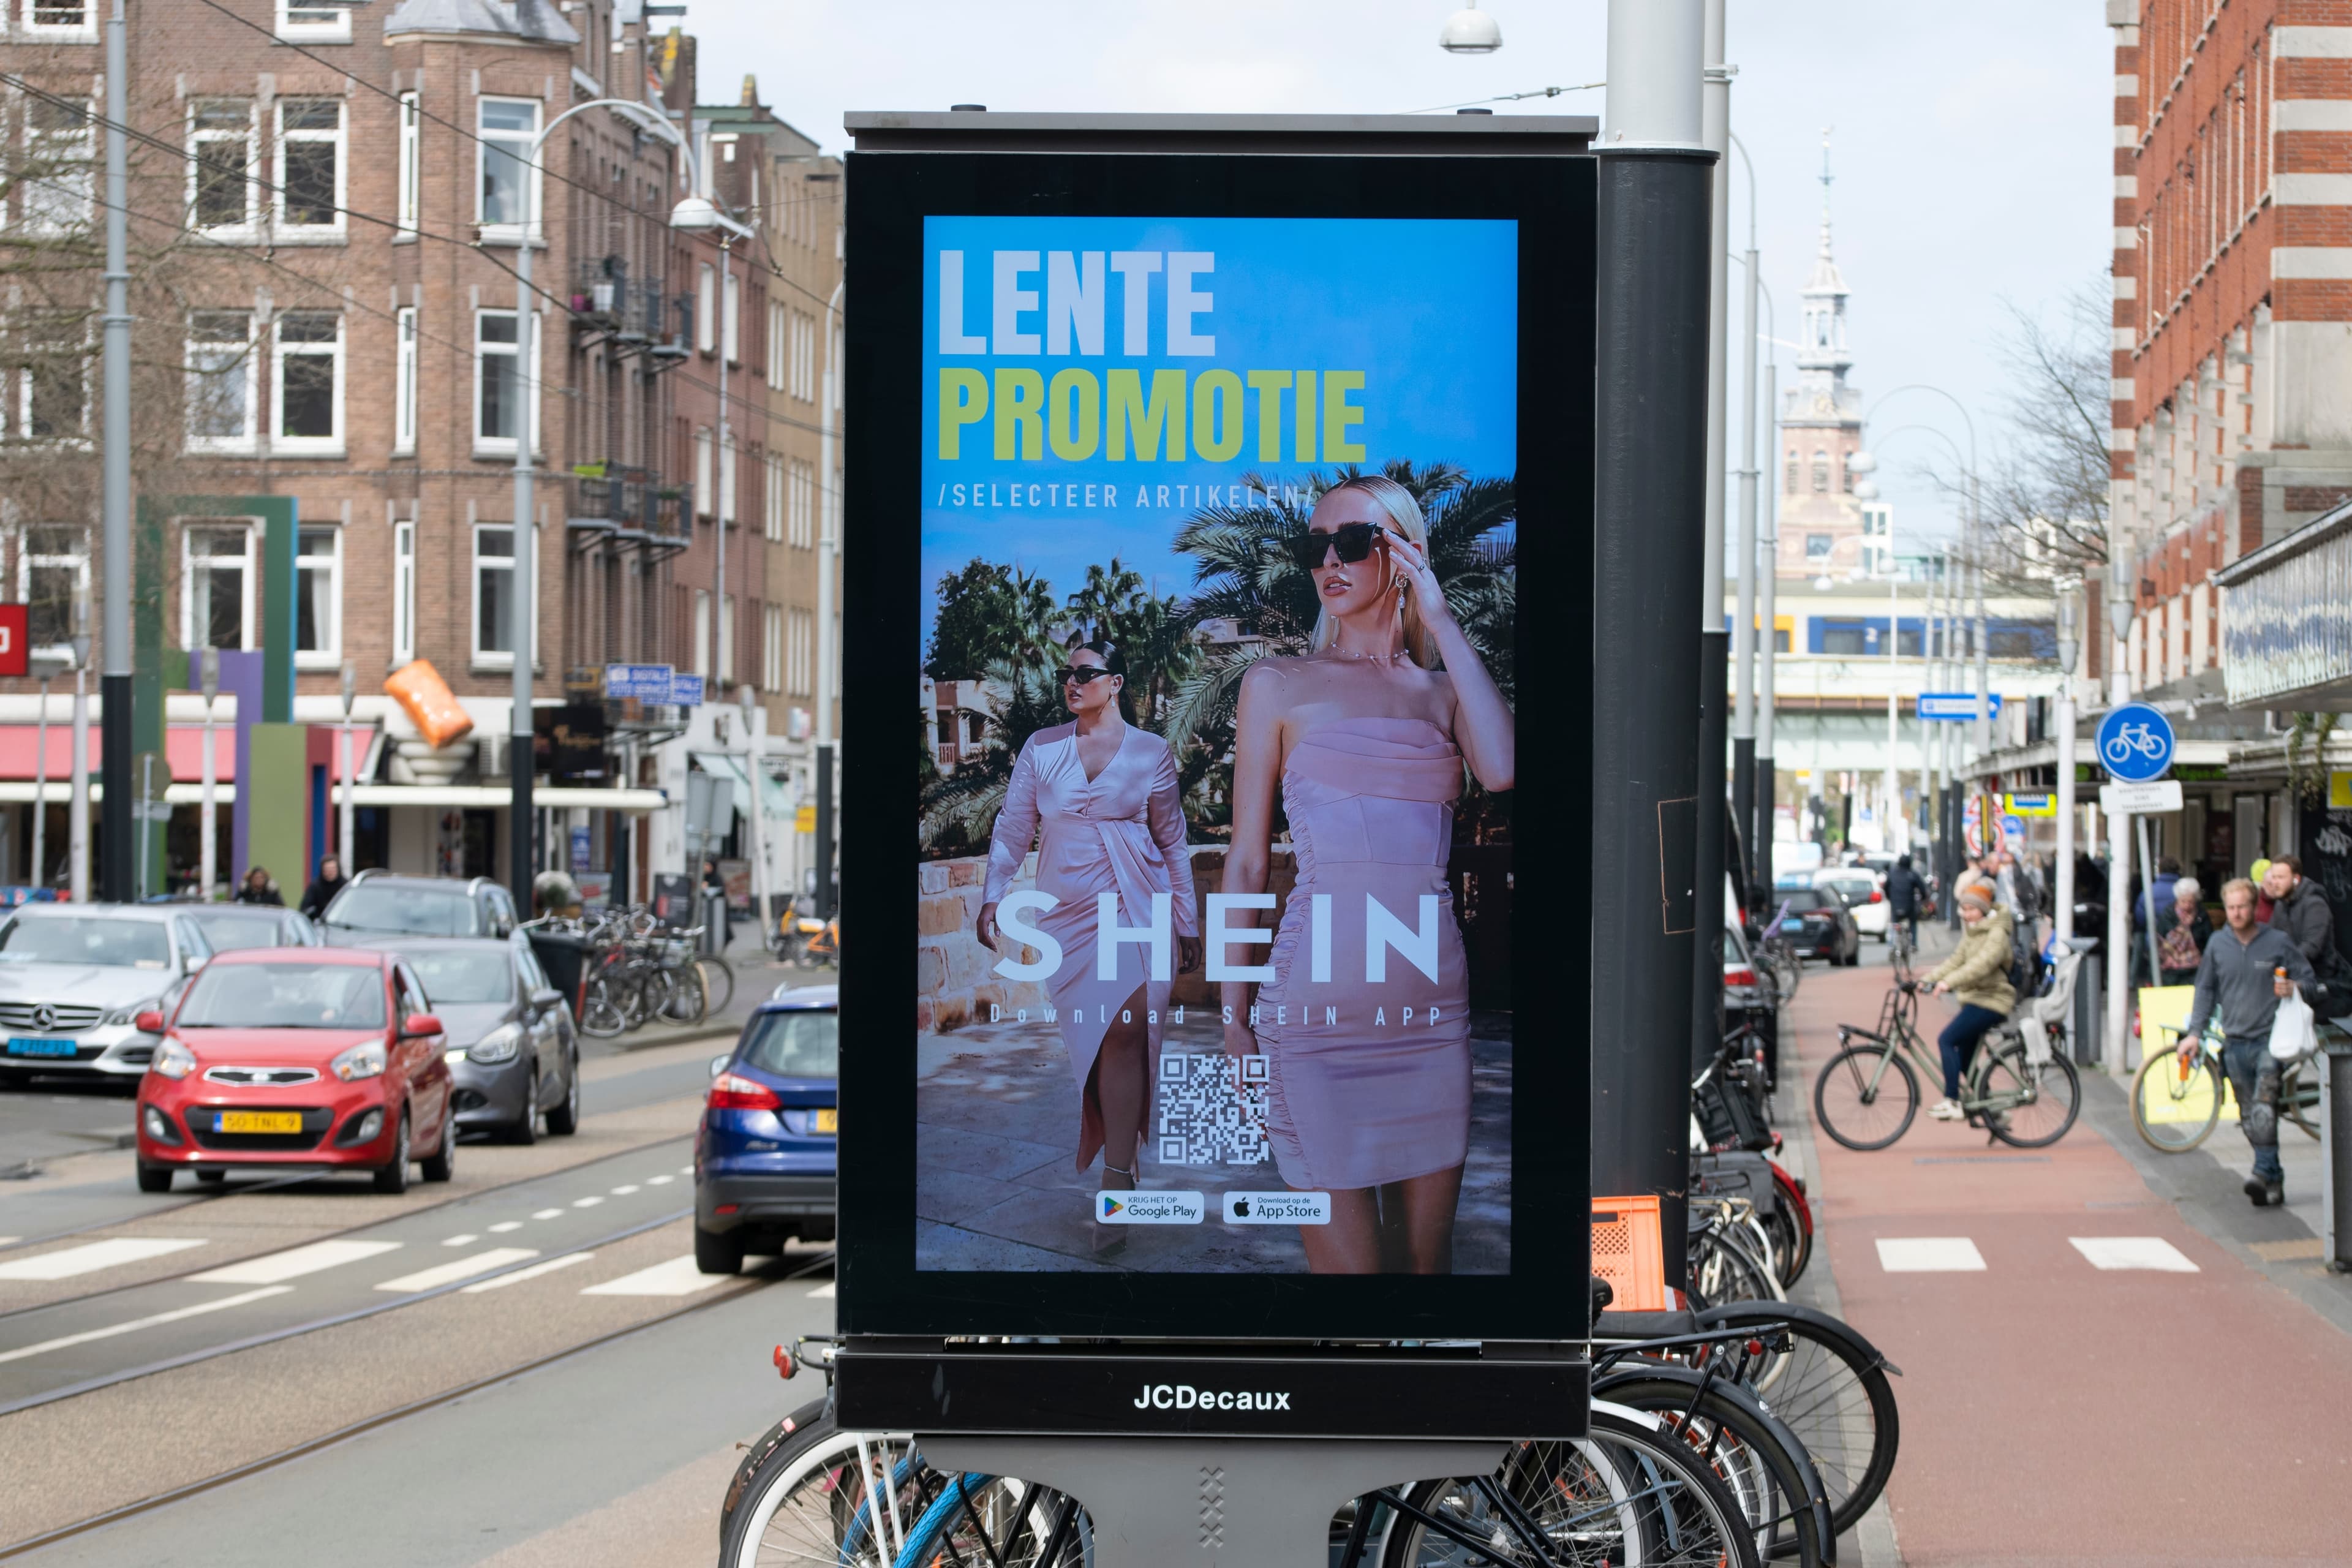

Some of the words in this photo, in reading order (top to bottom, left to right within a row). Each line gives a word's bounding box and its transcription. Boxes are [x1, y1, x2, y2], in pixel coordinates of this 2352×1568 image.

[938, 250, 1216, 356] LENTE
[938, 368, 1366, 463] PROMOTIE
[938, 483, 1117, 508] /SELECTEER
[993, 890, 1439, 985] SHEIN
[990, 1004, 1184, 1025] Download
[1223, 1006, 1336, 1025] SHEIN
[1375, 1006, 1440, 1026] APP
[1128, 1205, 1170, 1219] Google
[1173, 1205, 1197, 1219] Play
[1257, 1205, 1284, 1219] App
[1286, 1205, 1321, 1217] Store
[1134, 1384, 1291, 1410] JCDecaux
